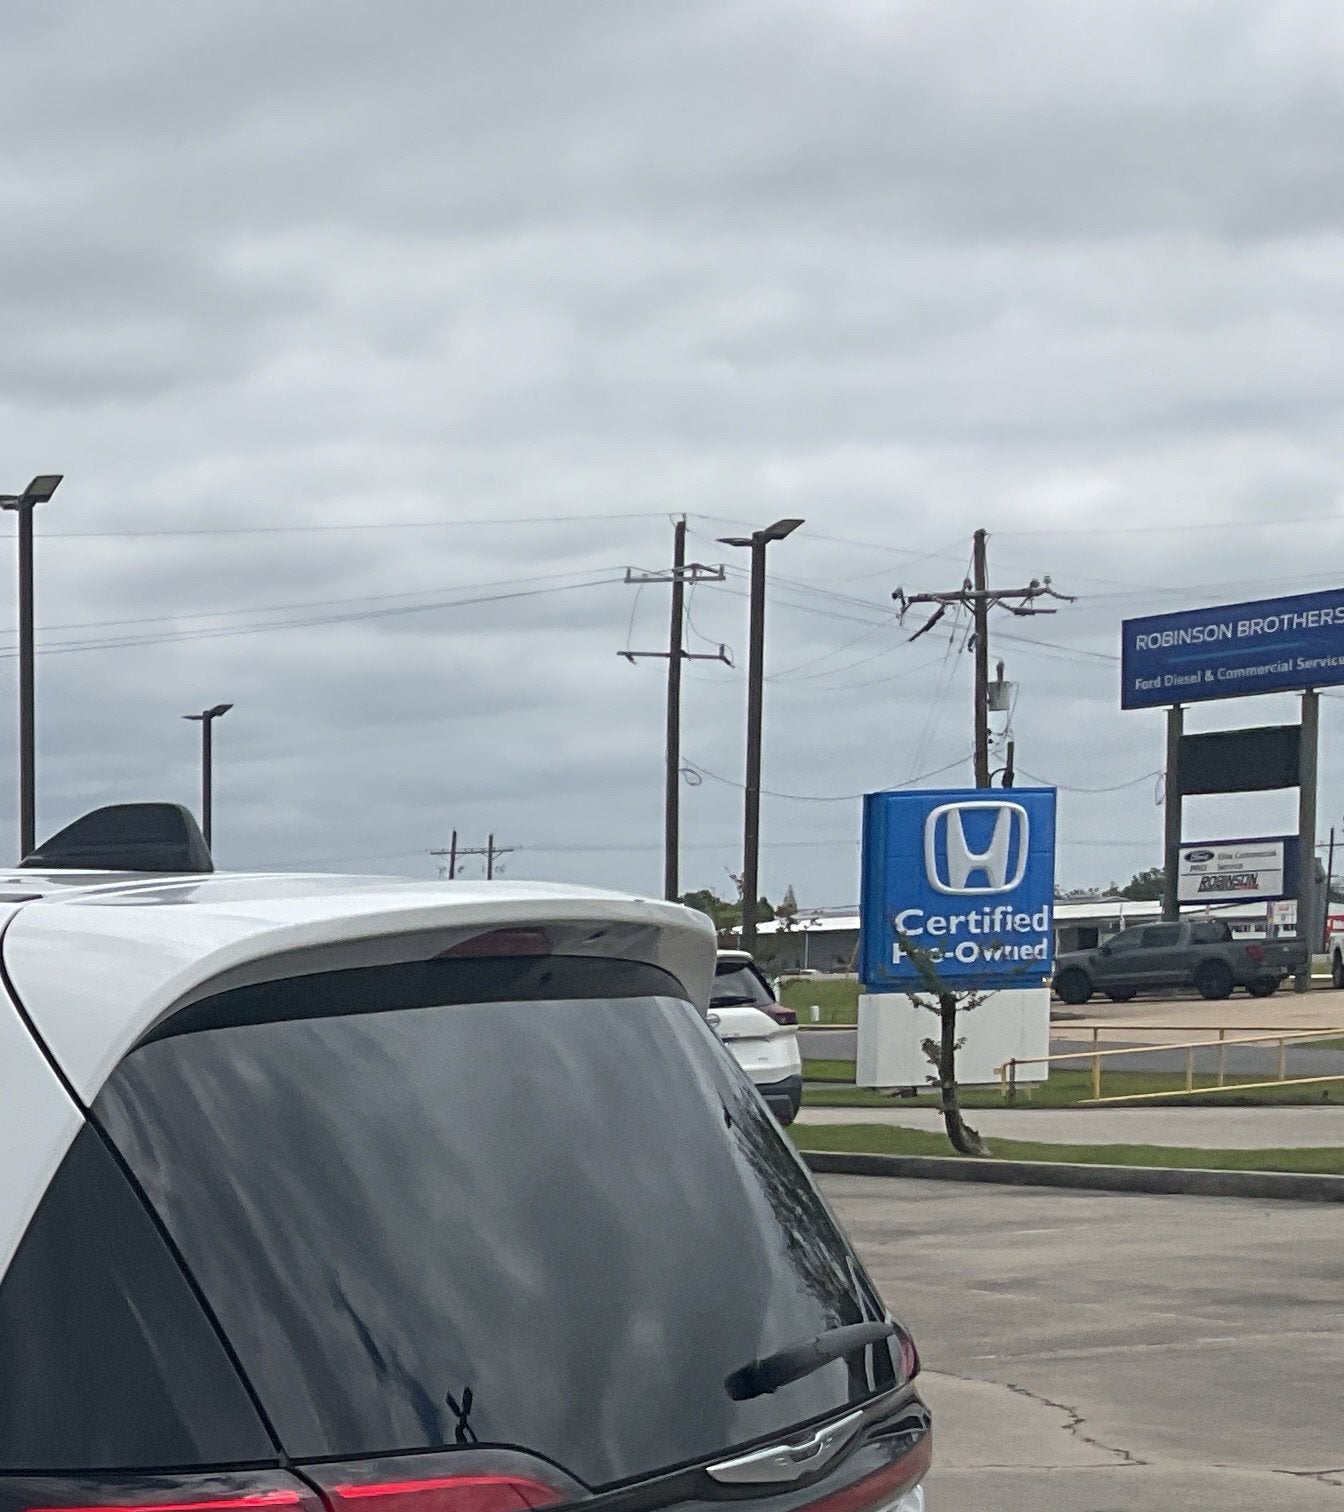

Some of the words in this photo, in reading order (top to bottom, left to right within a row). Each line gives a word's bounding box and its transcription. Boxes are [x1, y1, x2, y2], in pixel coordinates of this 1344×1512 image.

[1135, 622, 1233, 651] ROBINSON
[1237, 606, 1344, 637] BROTHERS
[1135, 674, 1161, 690] Ford
[1164, 670, 1201, 687] Diesel
[1204, 669, 1215, 682] &
[1217, 659, 1294, 680] Commercial
[894, 905, 1049, 936] Certified
